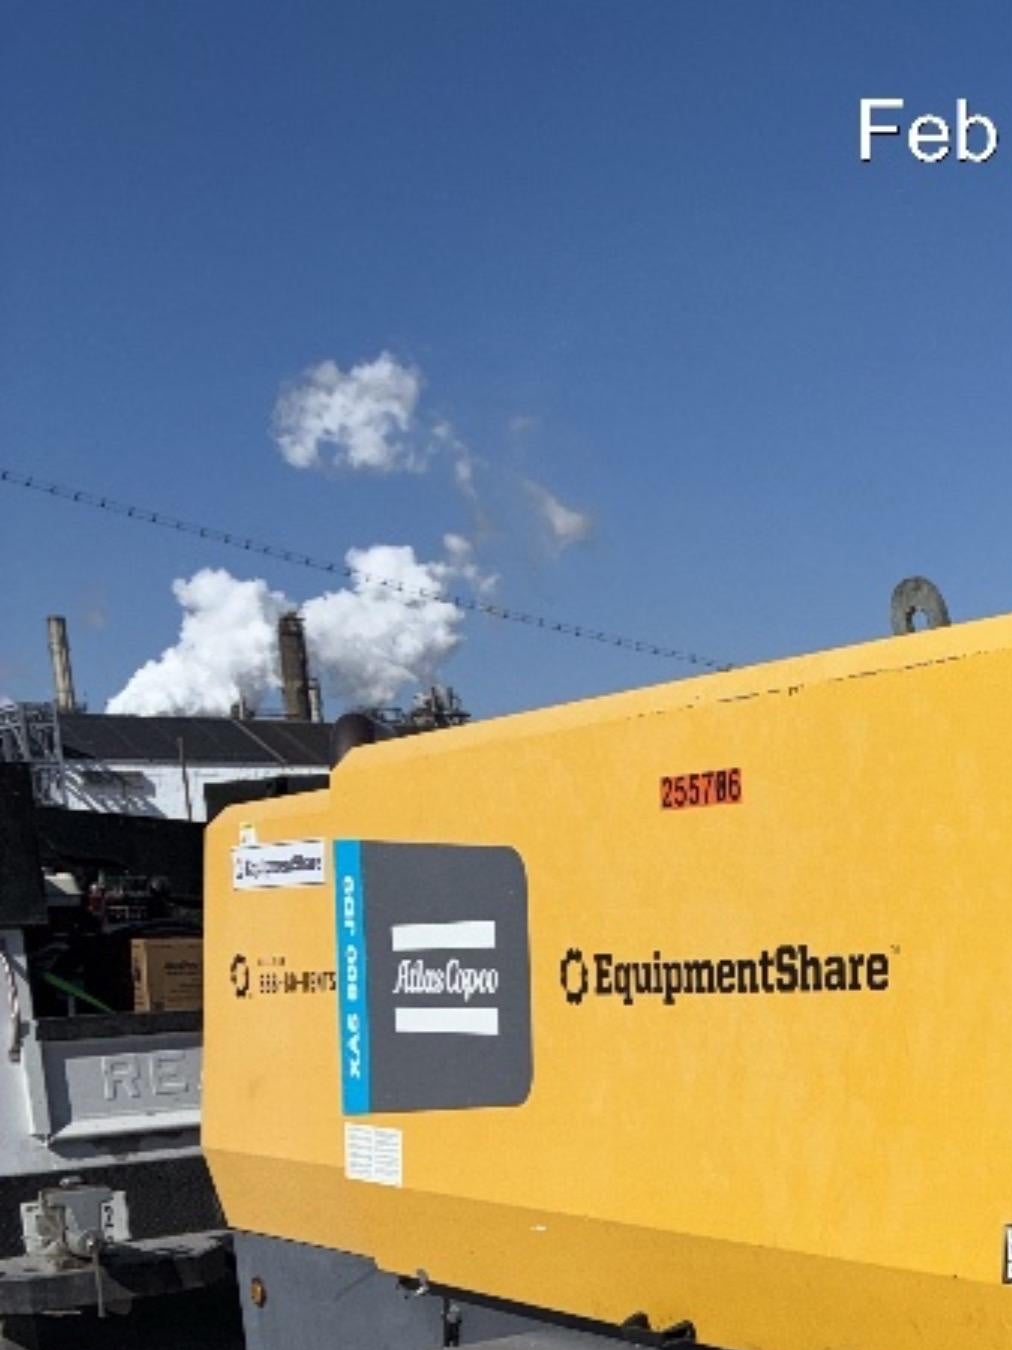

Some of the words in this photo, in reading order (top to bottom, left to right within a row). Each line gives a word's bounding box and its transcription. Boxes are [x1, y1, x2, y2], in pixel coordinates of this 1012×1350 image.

[661, 767, 742, 809] 255706
[392, 958, 445, 994] Atlas
[446, 958, 499, 1003] Copco
[594, 944, 889, 1005] EquipmentShare
